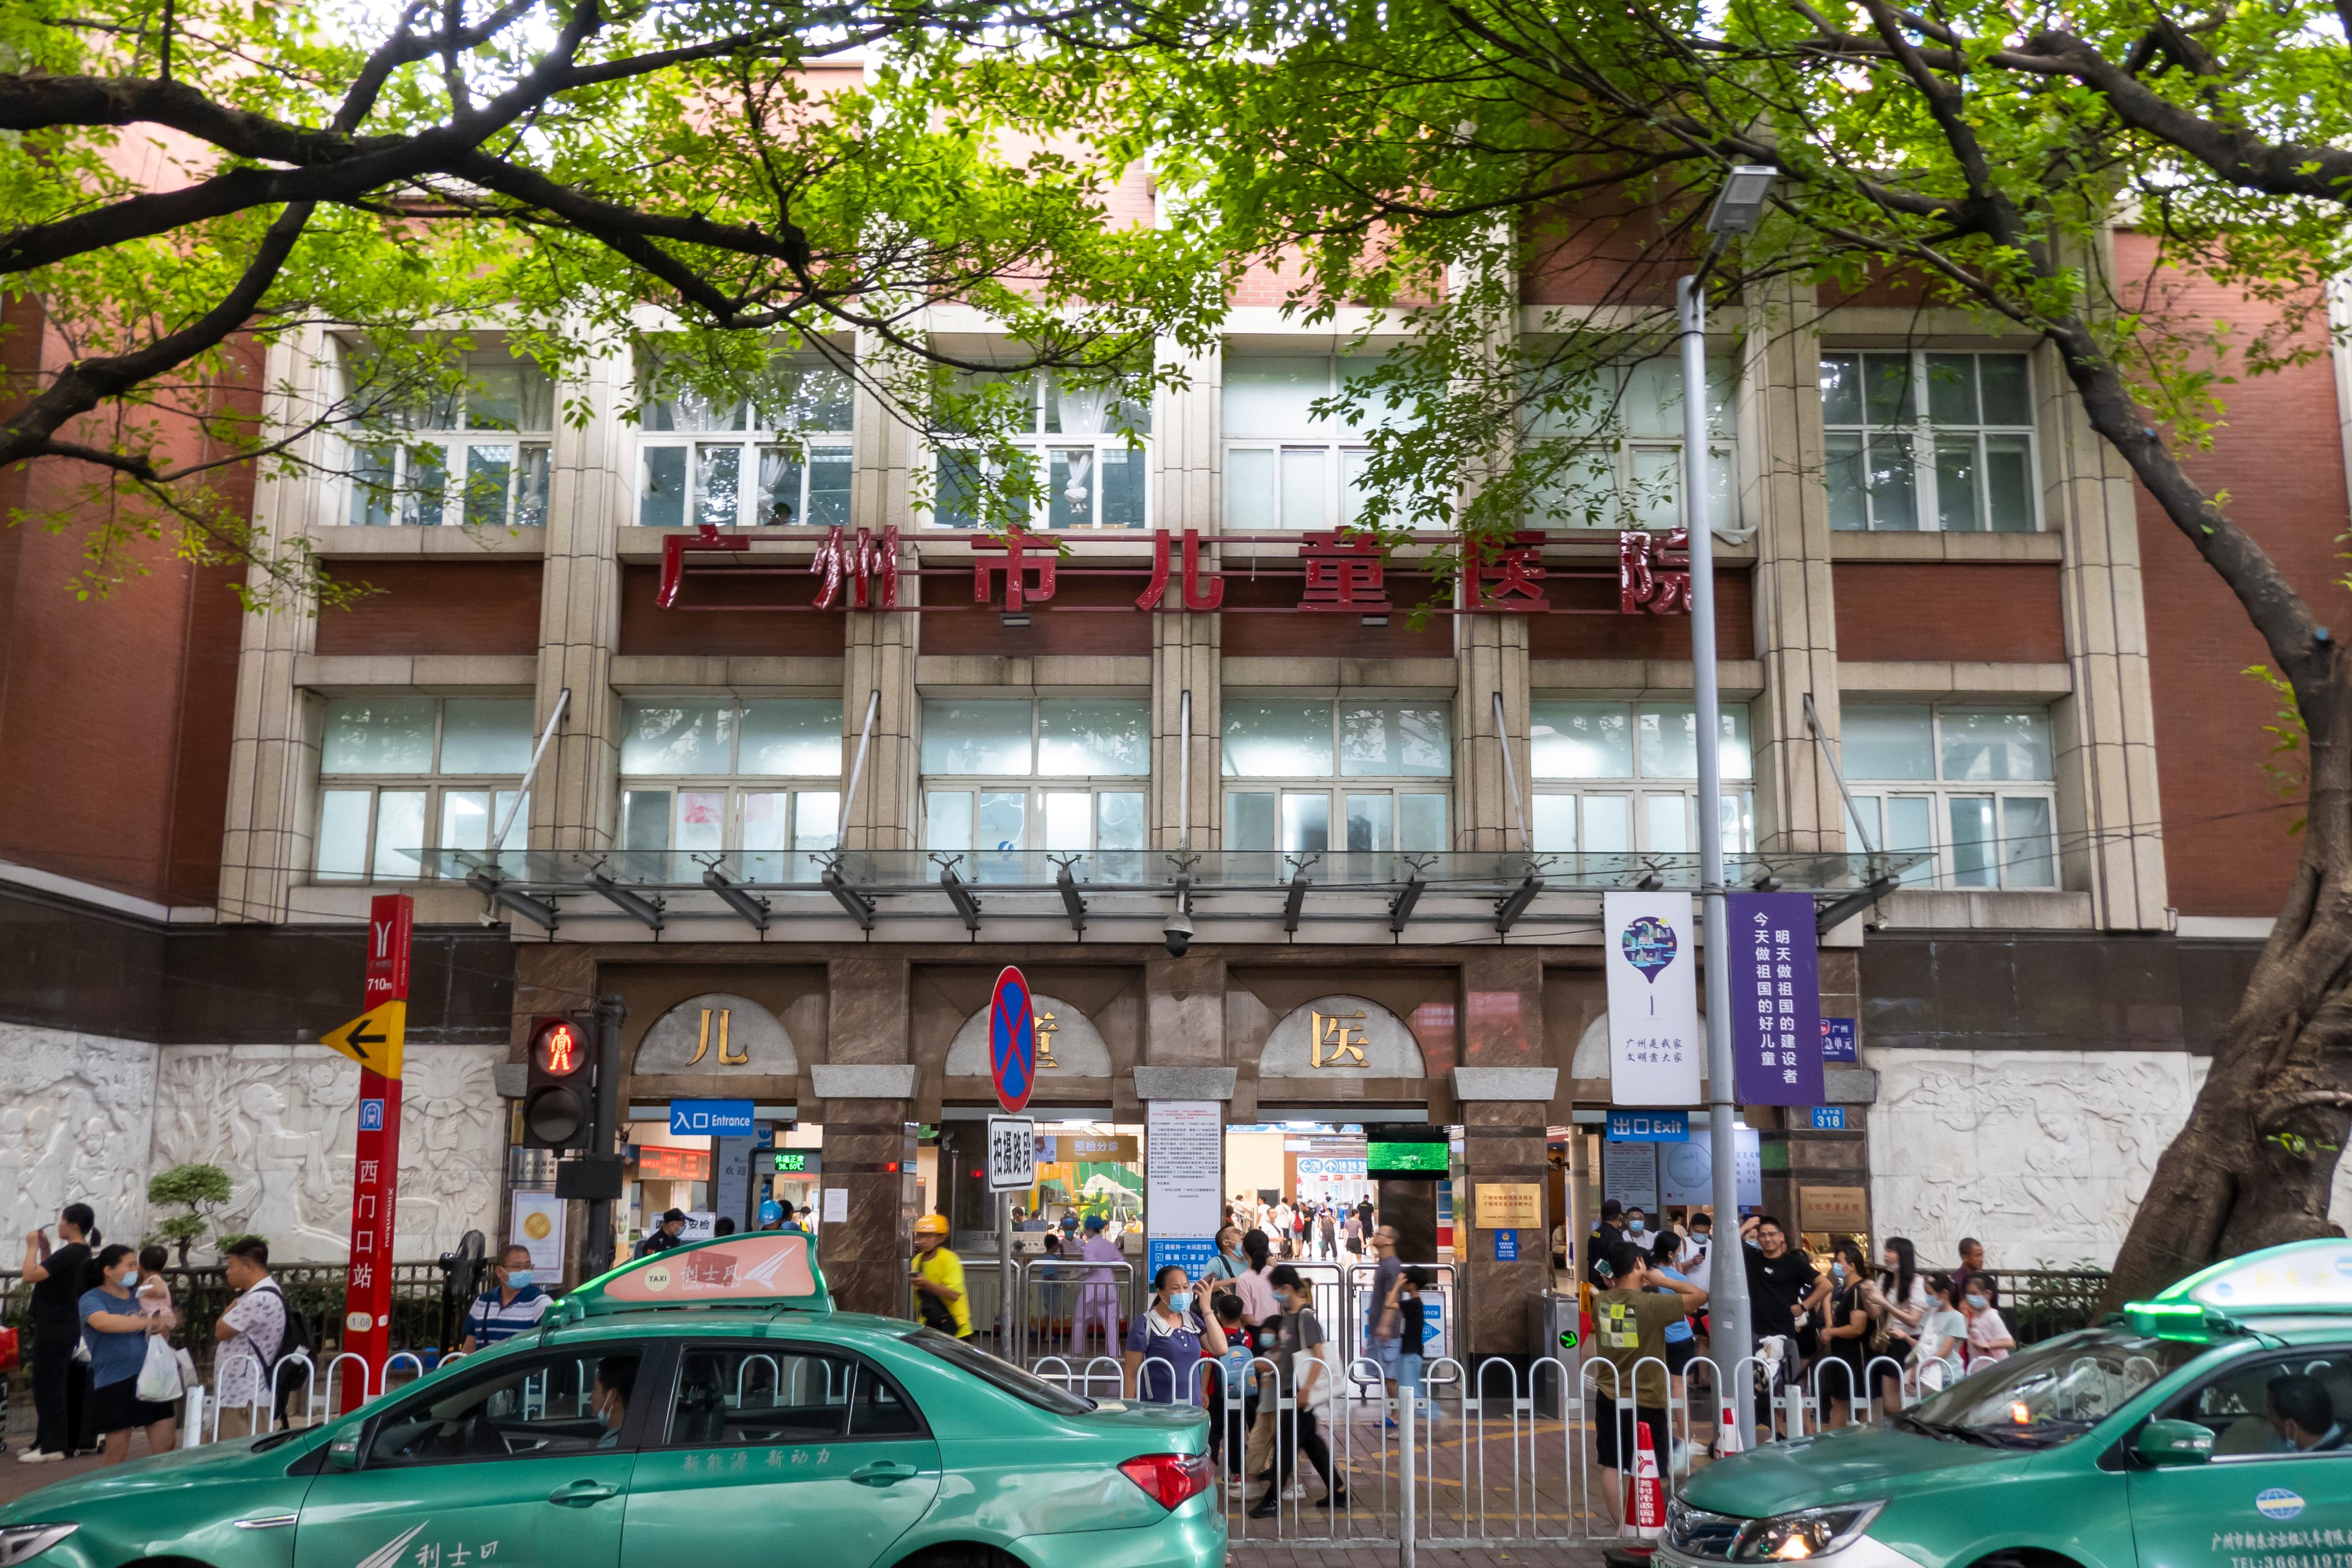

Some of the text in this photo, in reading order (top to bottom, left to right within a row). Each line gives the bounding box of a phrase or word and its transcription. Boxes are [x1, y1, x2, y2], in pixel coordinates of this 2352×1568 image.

[655, 523, 1692, 612] 广州市儿童医院
[1754, 912, 1776, 1066] 今天做祖国的好儿童
[1775, 930, 1798, 1084] 明天做祖国的建设者
[685, 1008, 748, 1066] 儿
[1311, 1010, 1370, 1068] 医
[1626, 1038, 1683, 1049] 广州是我家
[1822, 1038, 1853, 1050] 急单元
[674, 1112, 750, 1129] 入口 Entrance
[1613, 1117, 1682, 1135] 出口 Exit
[1817, 1115, 1840, 1127] 318
[775, 1155, 805, 1163] 体温正常
[993, 1130, 1031, 1177] 拍摄路段
[1074, 1140, 1118, 1152] 预检分诊
[353, 1159, 379, 1289] 西门口站
[385, 1188, 394, 1248] Ximenkou
